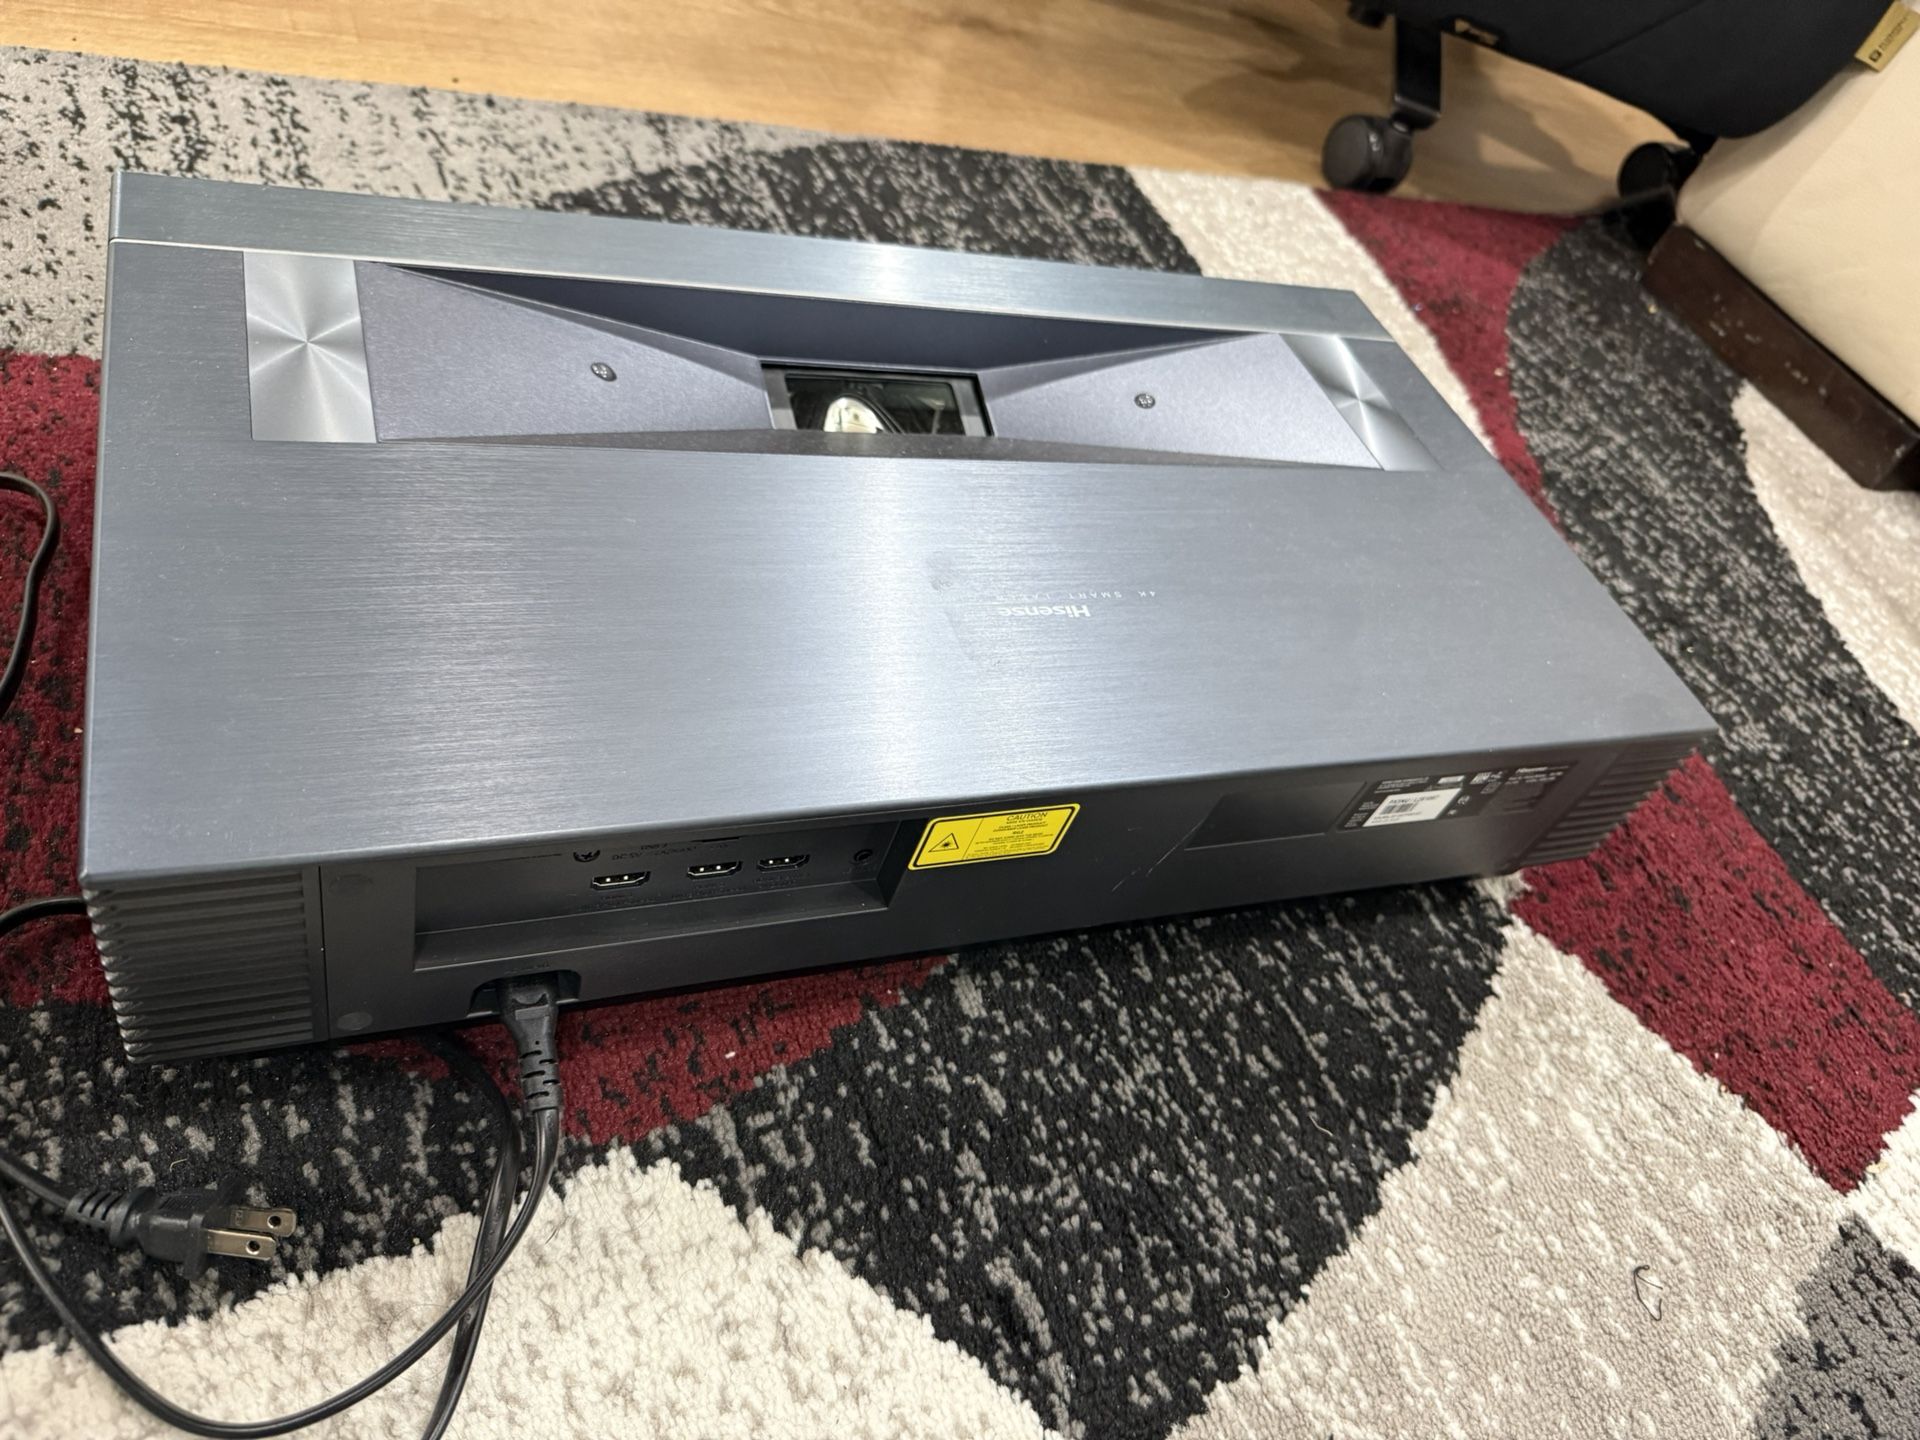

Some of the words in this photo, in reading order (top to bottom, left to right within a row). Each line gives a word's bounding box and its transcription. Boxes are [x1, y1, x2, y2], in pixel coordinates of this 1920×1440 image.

[1069, 591, 1123, 600] SMART
[1138, 590, 1156, 598] 4K
[999, 604, 1092, 618] Hisense
[1006, 811, 1048, 821] CAUTION
